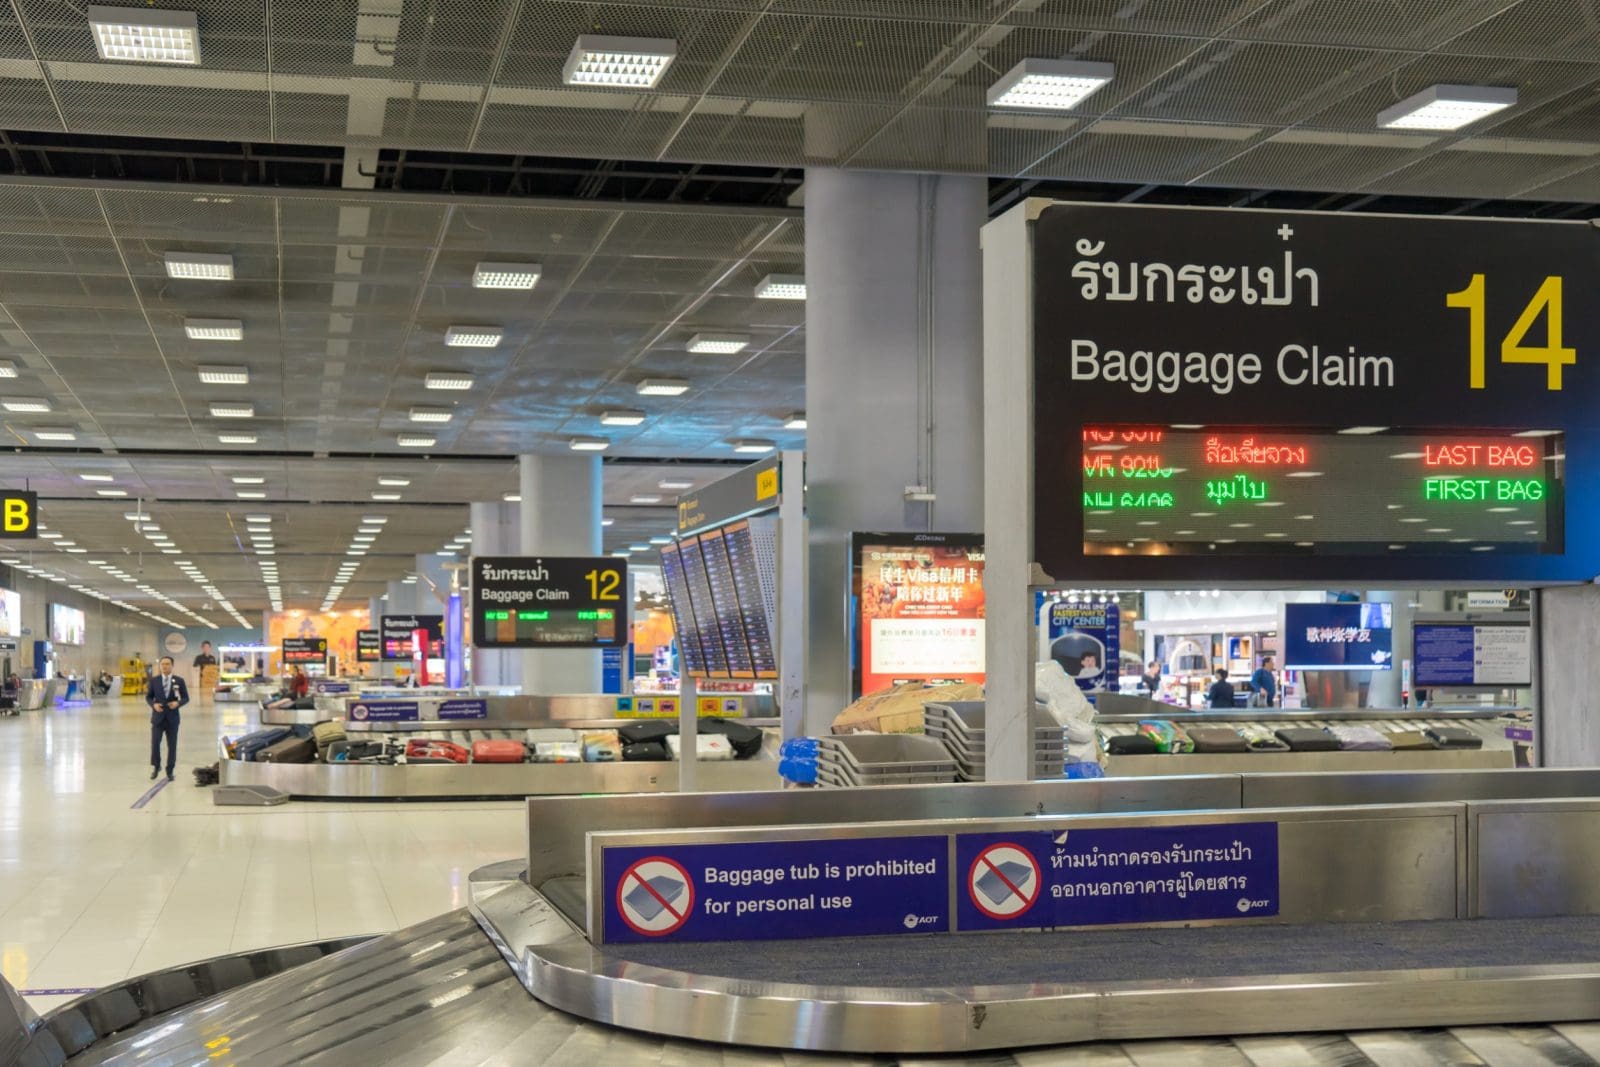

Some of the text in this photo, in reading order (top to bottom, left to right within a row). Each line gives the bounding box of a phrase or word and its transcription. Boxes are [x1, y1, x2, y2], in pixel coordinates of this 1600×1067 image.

[1071, 224, 1319, 307] รับกระเป๋า
[1446, 273, 1577, 391] 14
[1070, 339, 1395, 394] Baggage Claim
[1426, 445, 1534, 466] LAST BAG
[1425, 479, 1543, 500] FIRST BAG
[4, 498, 30, 532] B
[481, 588, 570, 602] Baggage Claim
[585, 569, 620, 600] 12
[1052, 617, 1106, 626] CITY CENTER
[704, 858, 937, 886] Baggage tub is prohibited
[704, 894, 853, 917] for personal use
[1250, 899, 1270, 908] AOT
[918, 915, 939, 925] AOT
